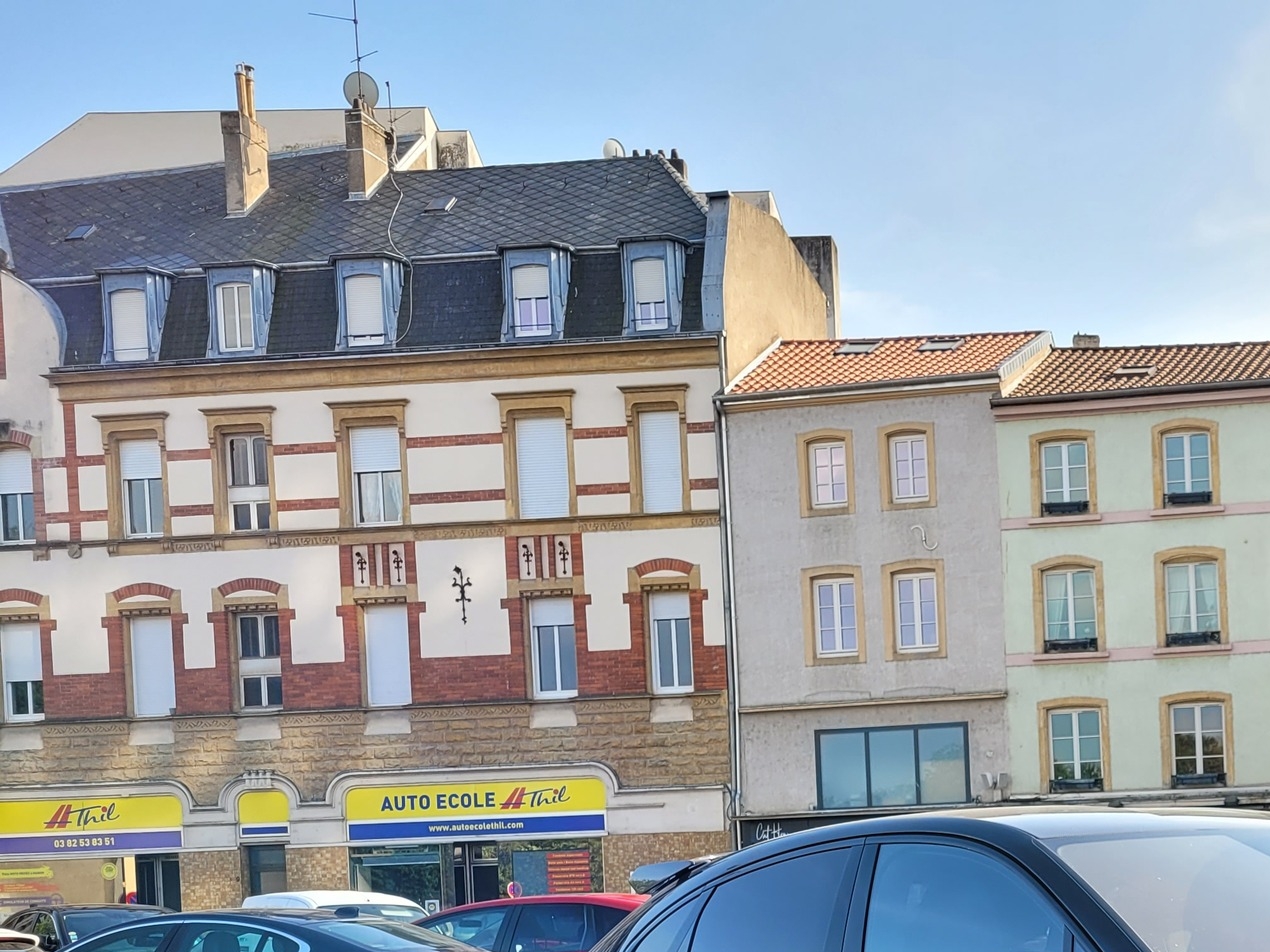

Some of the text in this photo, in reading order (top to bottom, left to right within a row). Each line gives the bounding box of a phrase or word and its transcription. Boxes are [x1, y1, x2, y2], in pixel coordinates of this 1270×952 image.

[381, 794, 430, 811] AUTO
[436, 792, 496, 809] ECOLE
[428, 821, 524, 833] www.autoecolethil.com
[54, 839, 65, 848] 03
[66, 839, 78, 847] 82
[79, 838, 90, 847] 53
[104, 837, 115, 846] 51
